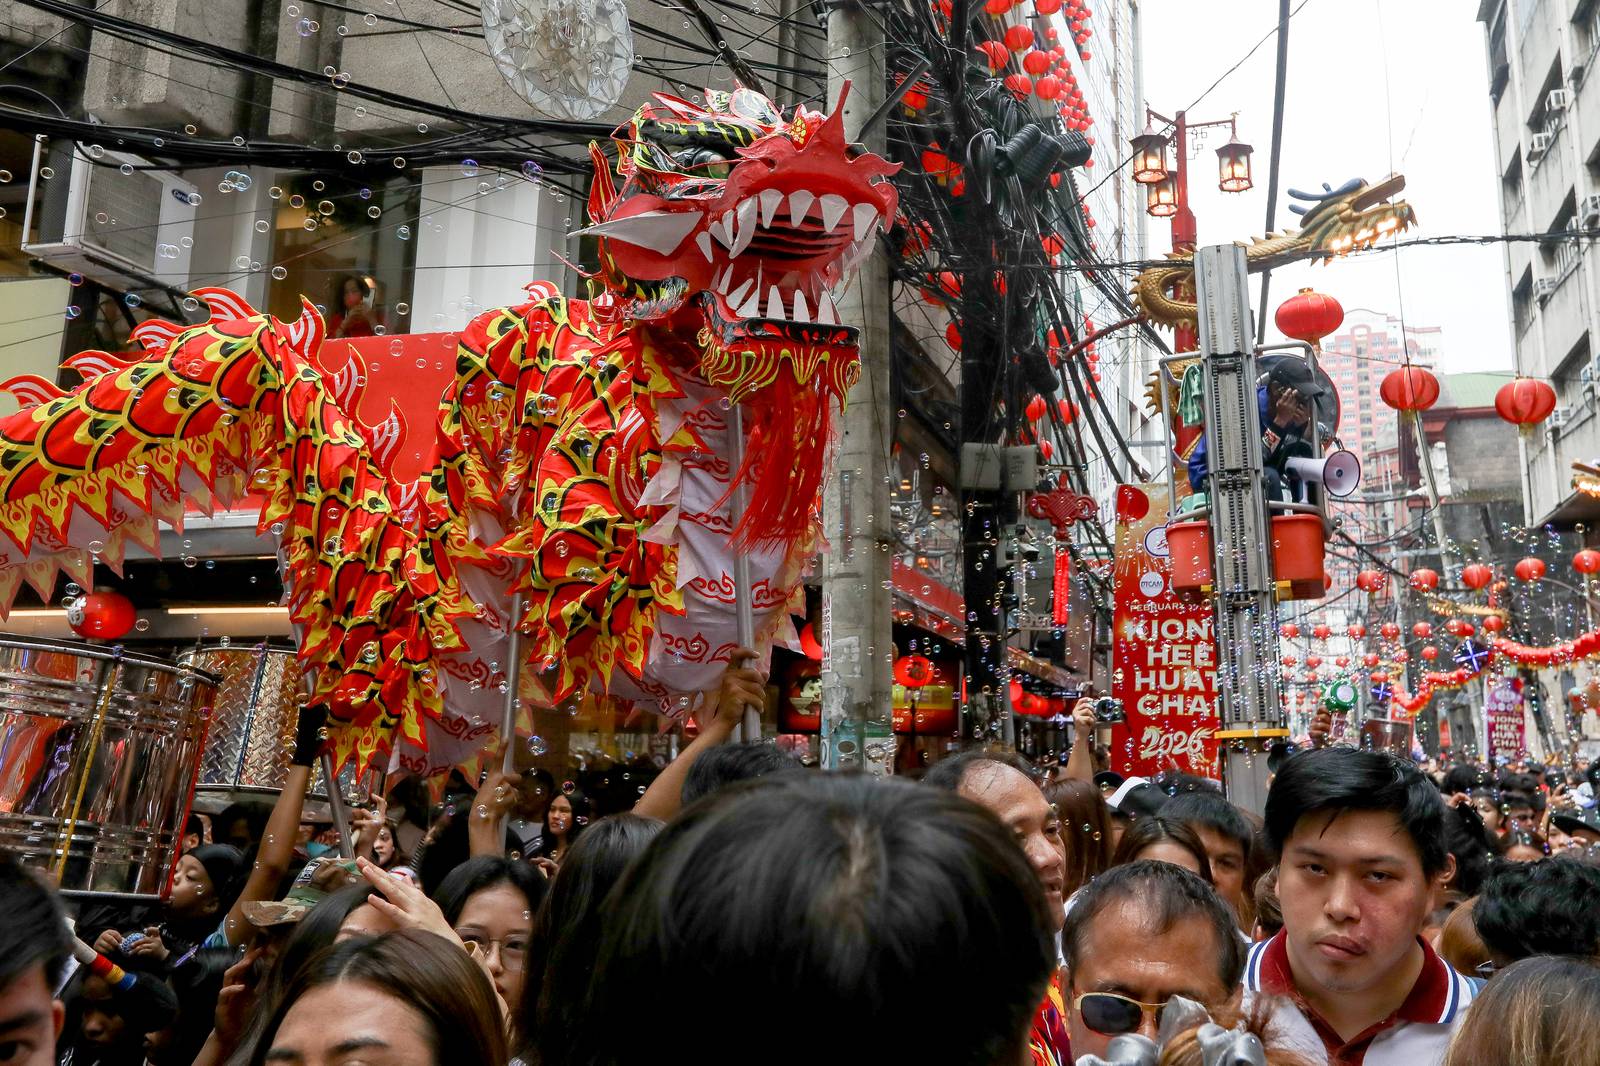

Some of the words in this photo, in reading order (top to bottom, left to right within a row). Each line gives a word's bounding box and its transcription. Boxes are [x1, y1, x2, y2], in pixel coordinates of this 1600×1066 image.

[1124, 618, 1215, 641] KION
[1147, 644, 1214, 666] HEE
[1140, 726, 1210, 760] 2026
